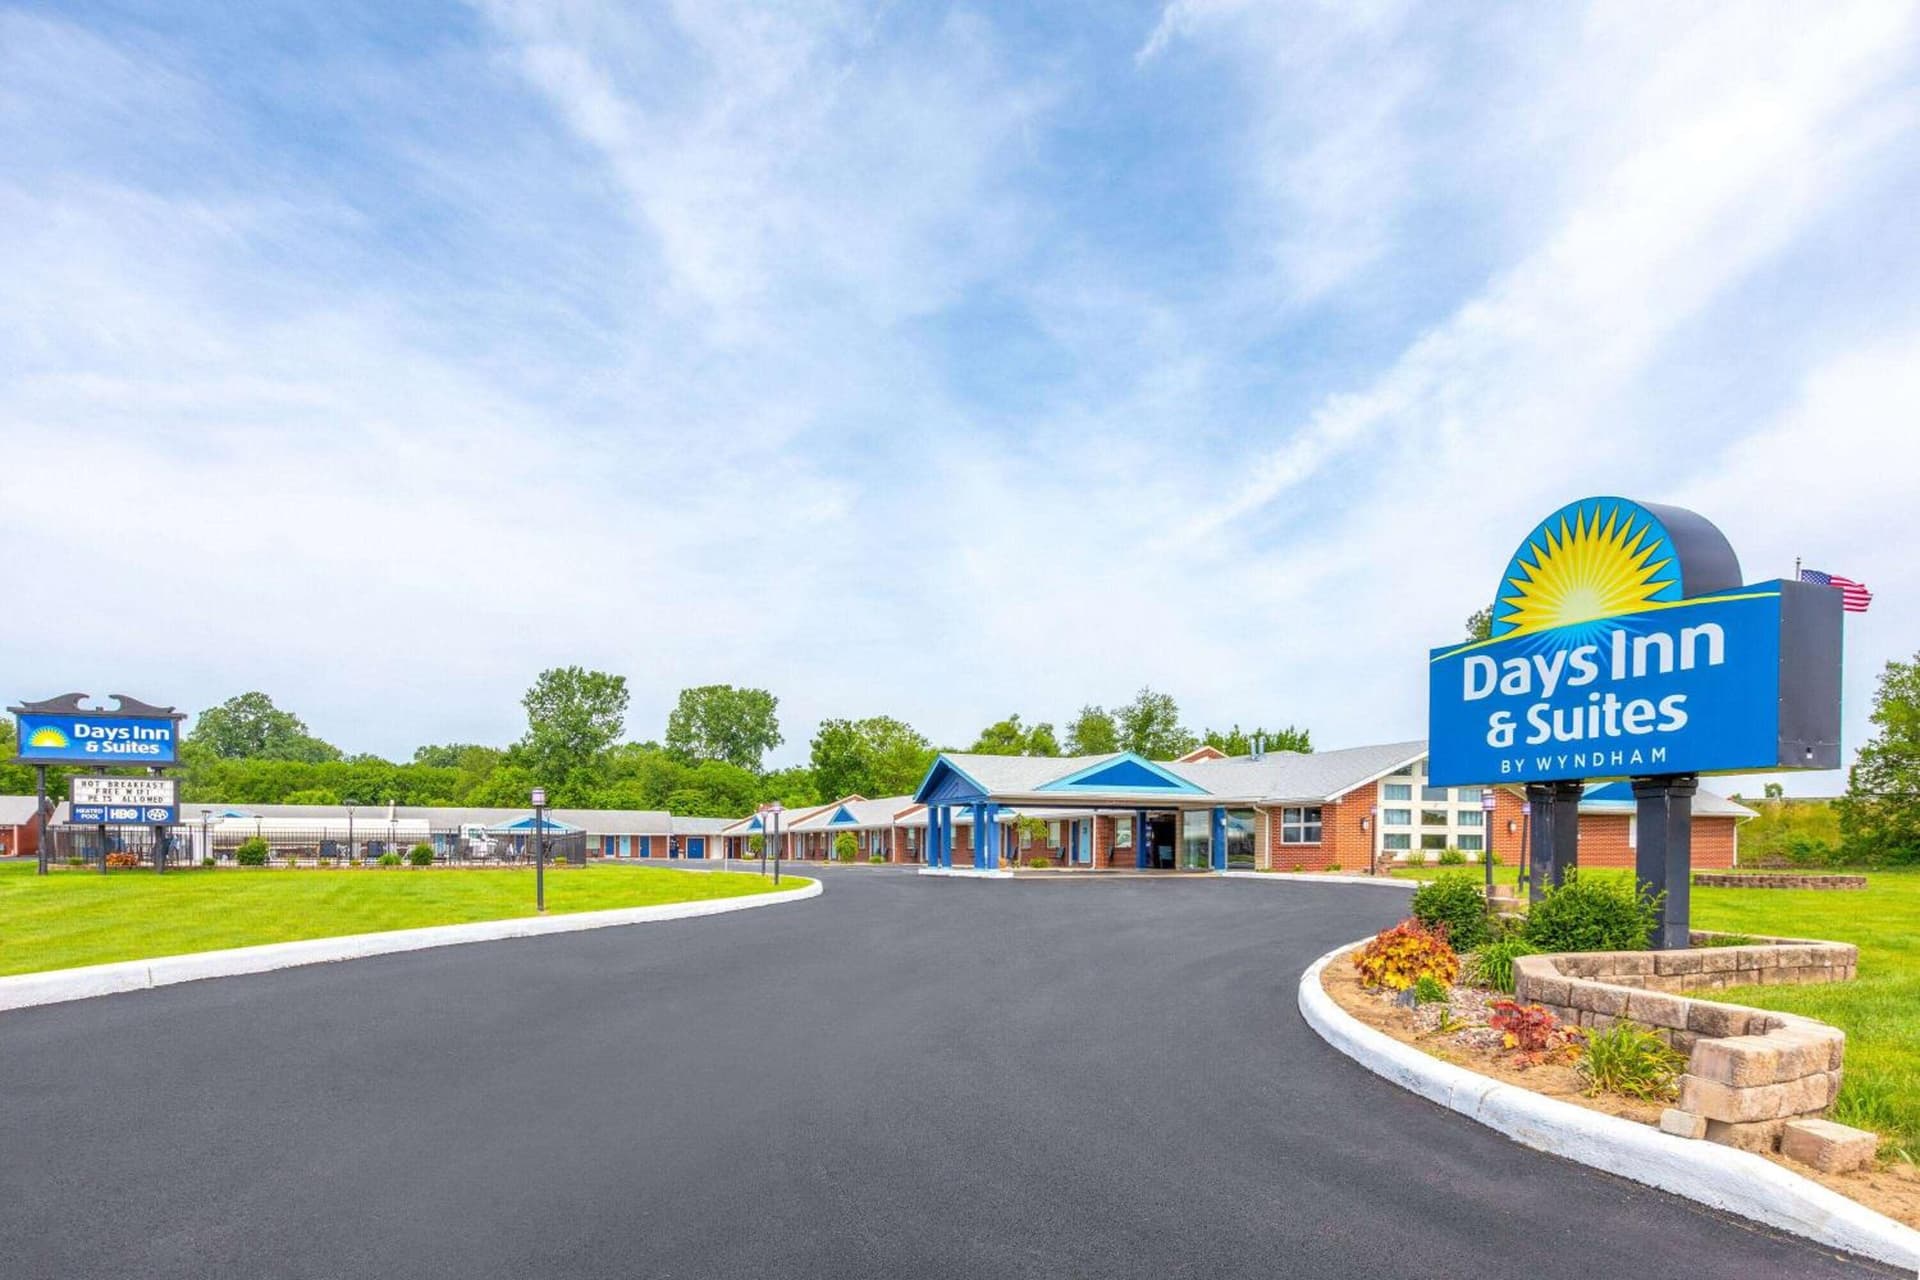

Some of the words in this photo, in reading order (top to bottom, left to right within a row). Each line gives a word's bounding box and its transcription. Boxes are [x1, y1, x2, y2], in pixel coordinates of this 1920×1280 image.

[1463, 645, 1599, 701] Days
[1611, 622, 1725, 680] Inn
[1486, 710, 1517, 748] &
[1525, 692, 1689, 745] Suites
[74, 724, 130, 740] Days
[134, 726, 170, 740] Inn
[87, 741, 99, 752] &
[102, 740, 160, 754] Suites
[1501, 758, 1525, 774] BY
[1536, 747, 1666, 772] WYNDHAM
[107, 781, 164, 789] BREAKFAST
[110, 808, 138, 819] HBO
